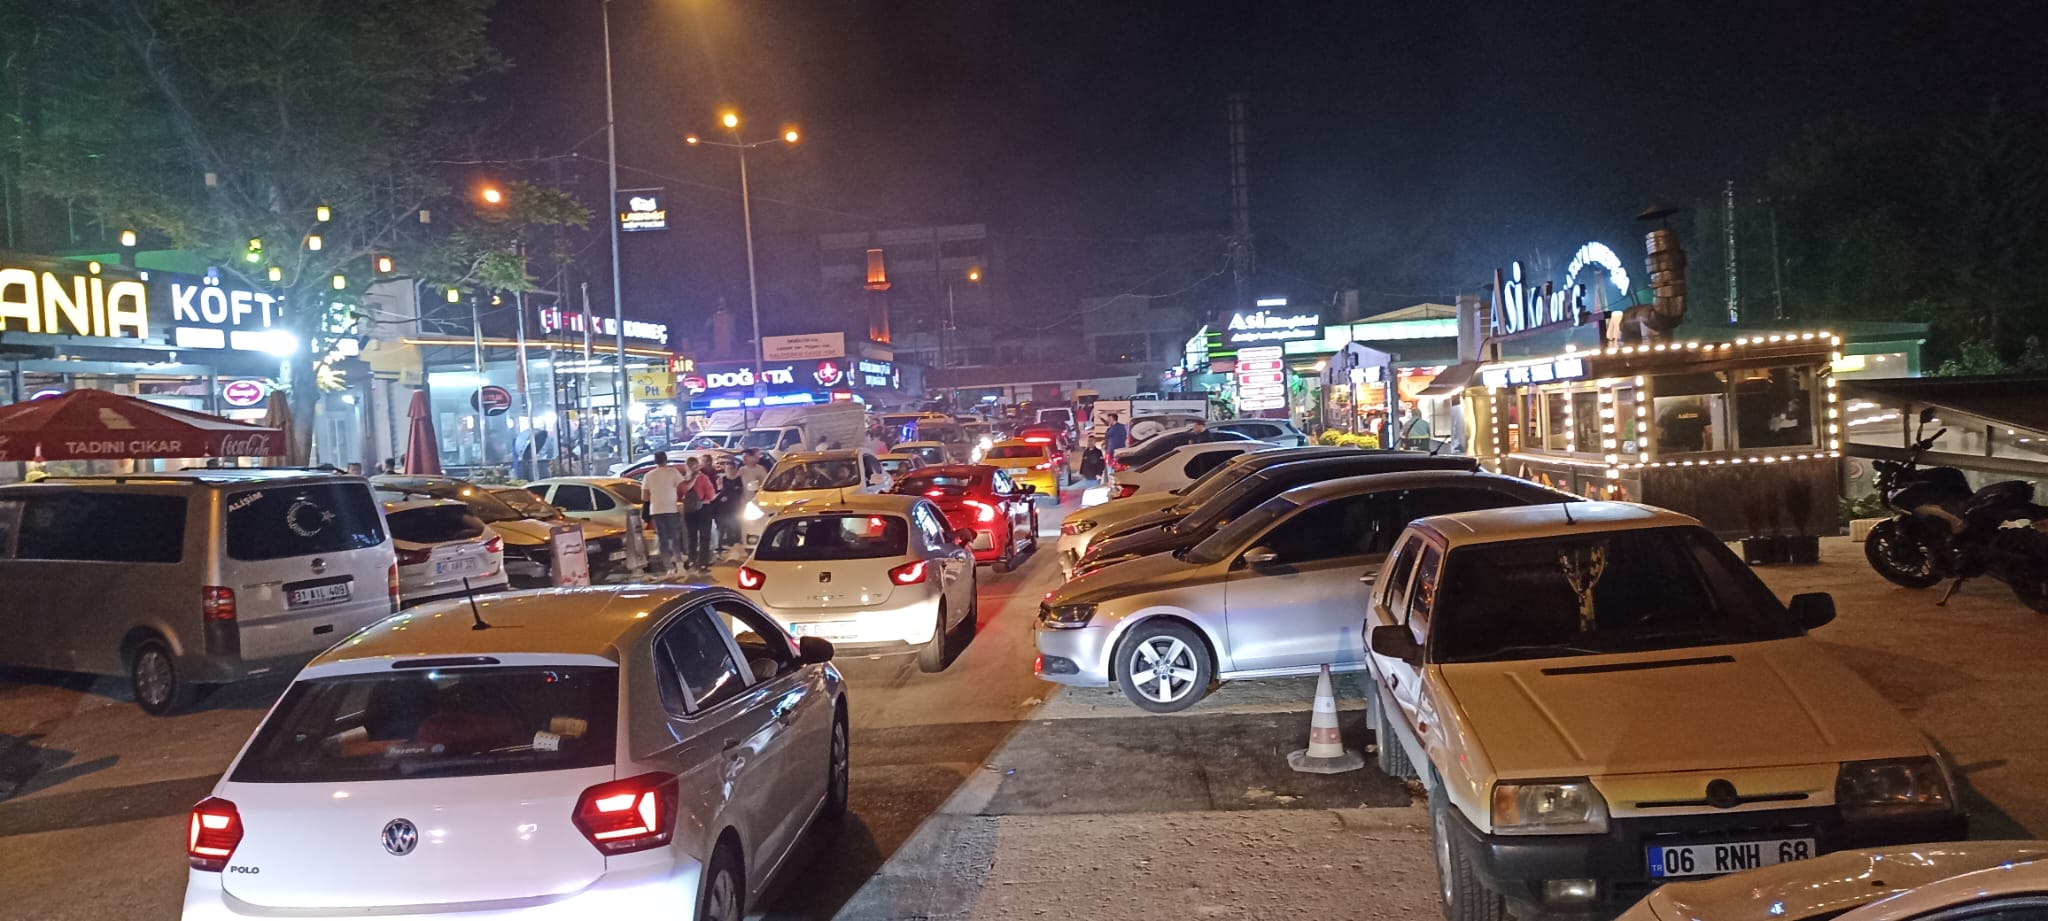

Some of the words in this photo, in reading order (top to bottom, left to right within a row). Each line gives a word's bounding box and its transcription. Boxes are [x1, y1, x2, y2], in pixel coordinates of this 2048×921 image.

[171, 276, 285, 328] KÖFT
[65, 441, 125, 455] TADINI
[129, 440, 181, 455] ÇIKAR
[1665, 848, 1694, 874] 06
[1715, 843, 1761, 872] RNH
[1779, 840, 1809, 863] 68
[230, 865, 260, 874] POLO
